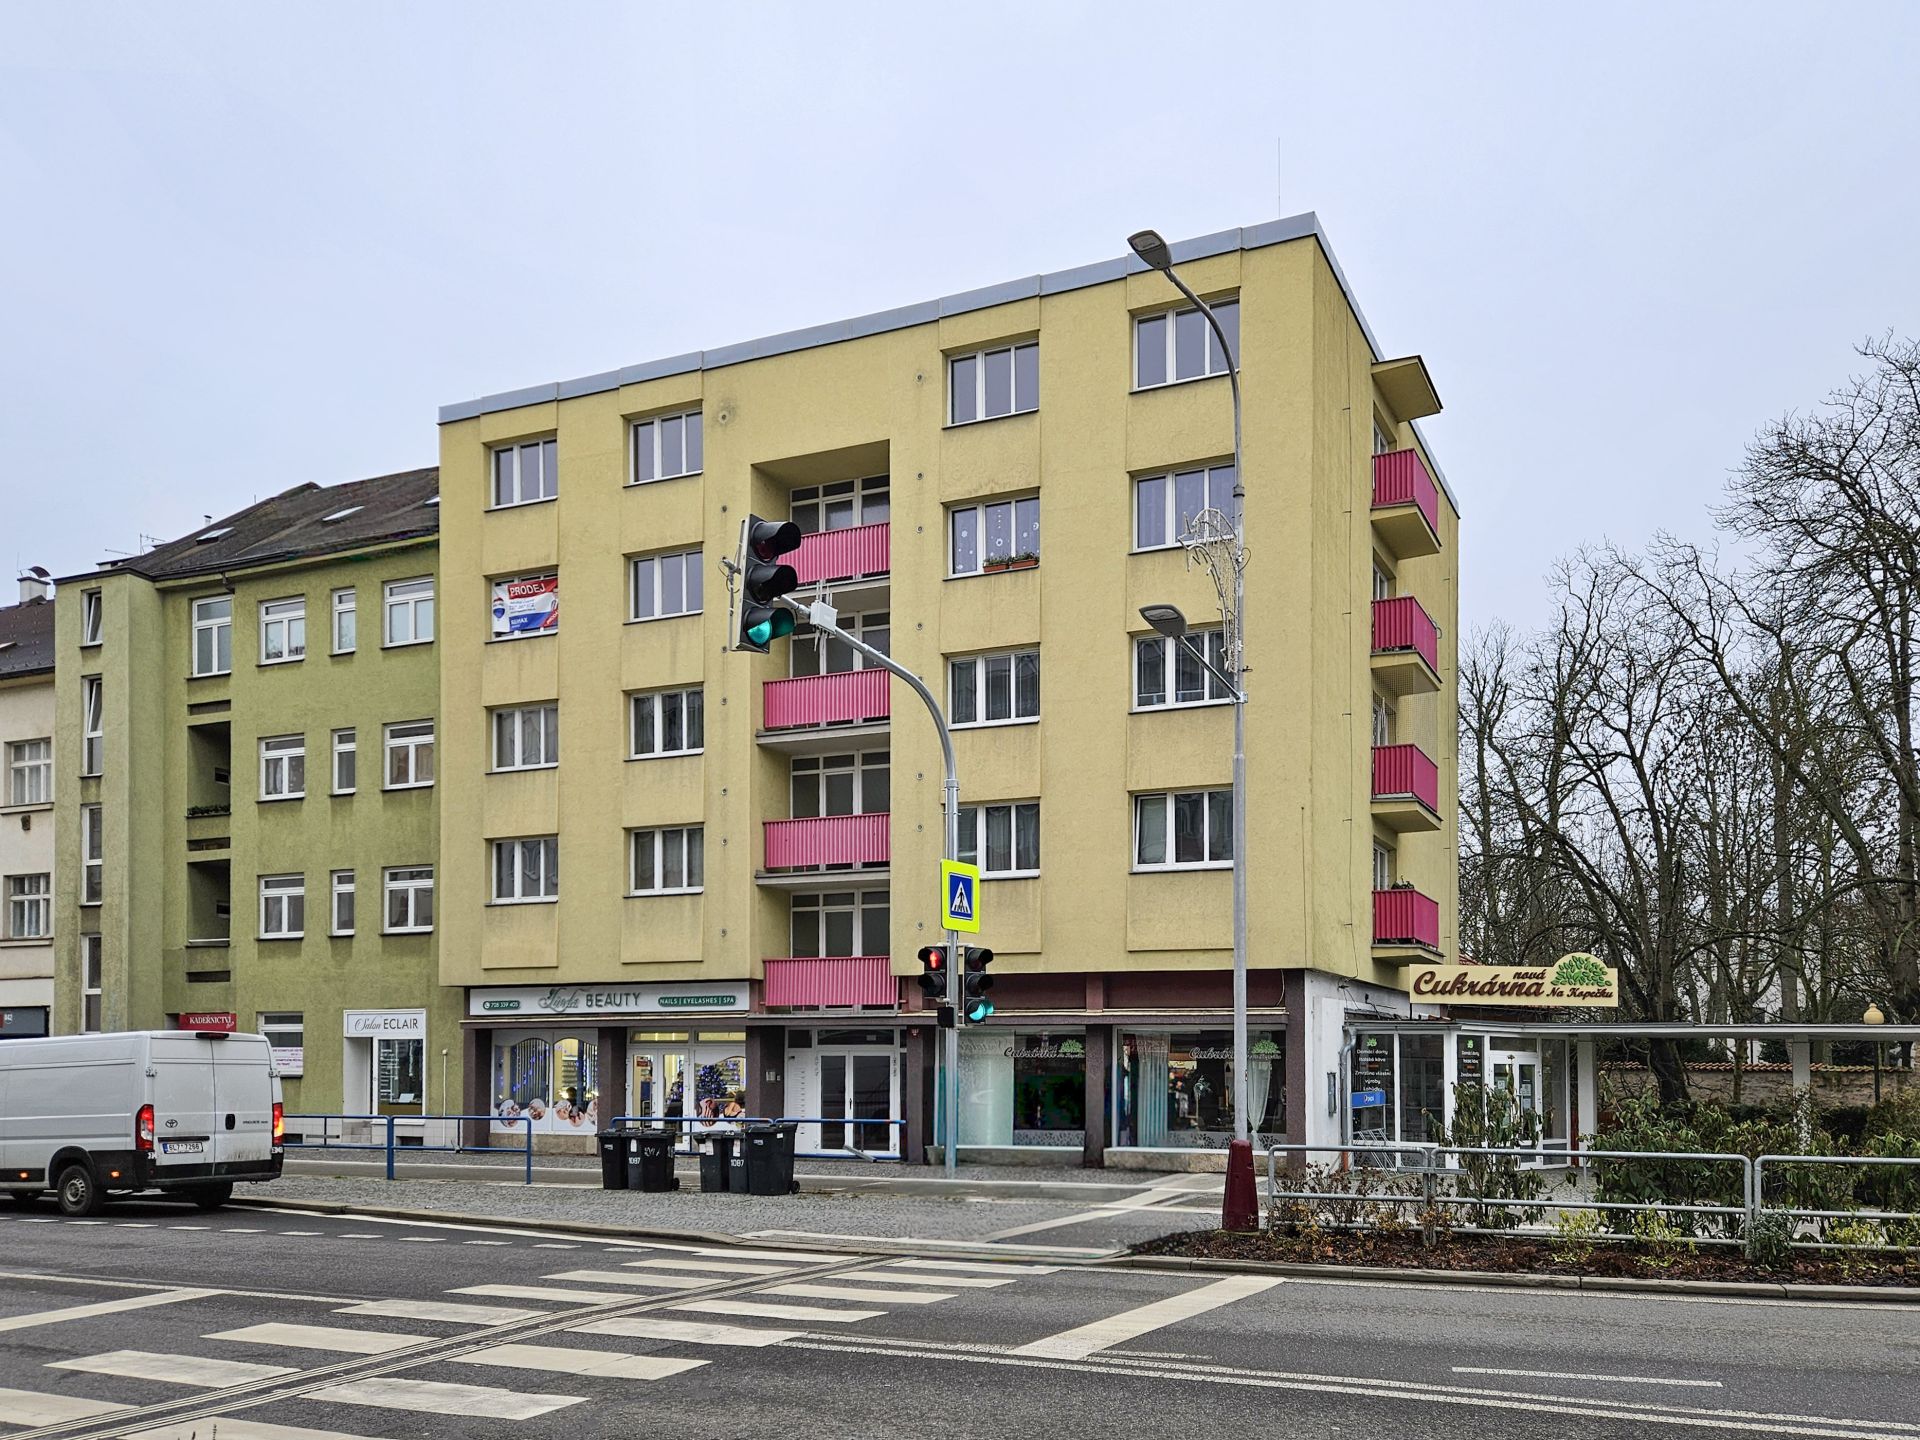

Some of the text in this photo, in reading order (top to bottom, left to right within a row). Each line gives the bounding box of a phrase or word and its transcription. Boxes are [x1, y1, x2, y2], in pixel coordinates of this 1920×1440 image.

[509, 583, 546, 596] PRODEJ
[1513, 969, 1547, 980] nová
[1413, 970, 1545, 998] Cukrárna
[585, 992, 642, 1008] BEAUTY
[1546, 987, 1614, 1000] Na Kopečku
[354, 1016, 418, 1031] Salon ECLAIR
[628, 1156, 641, 1165] 1087
[730, 1159, 745, 1167] 1087
